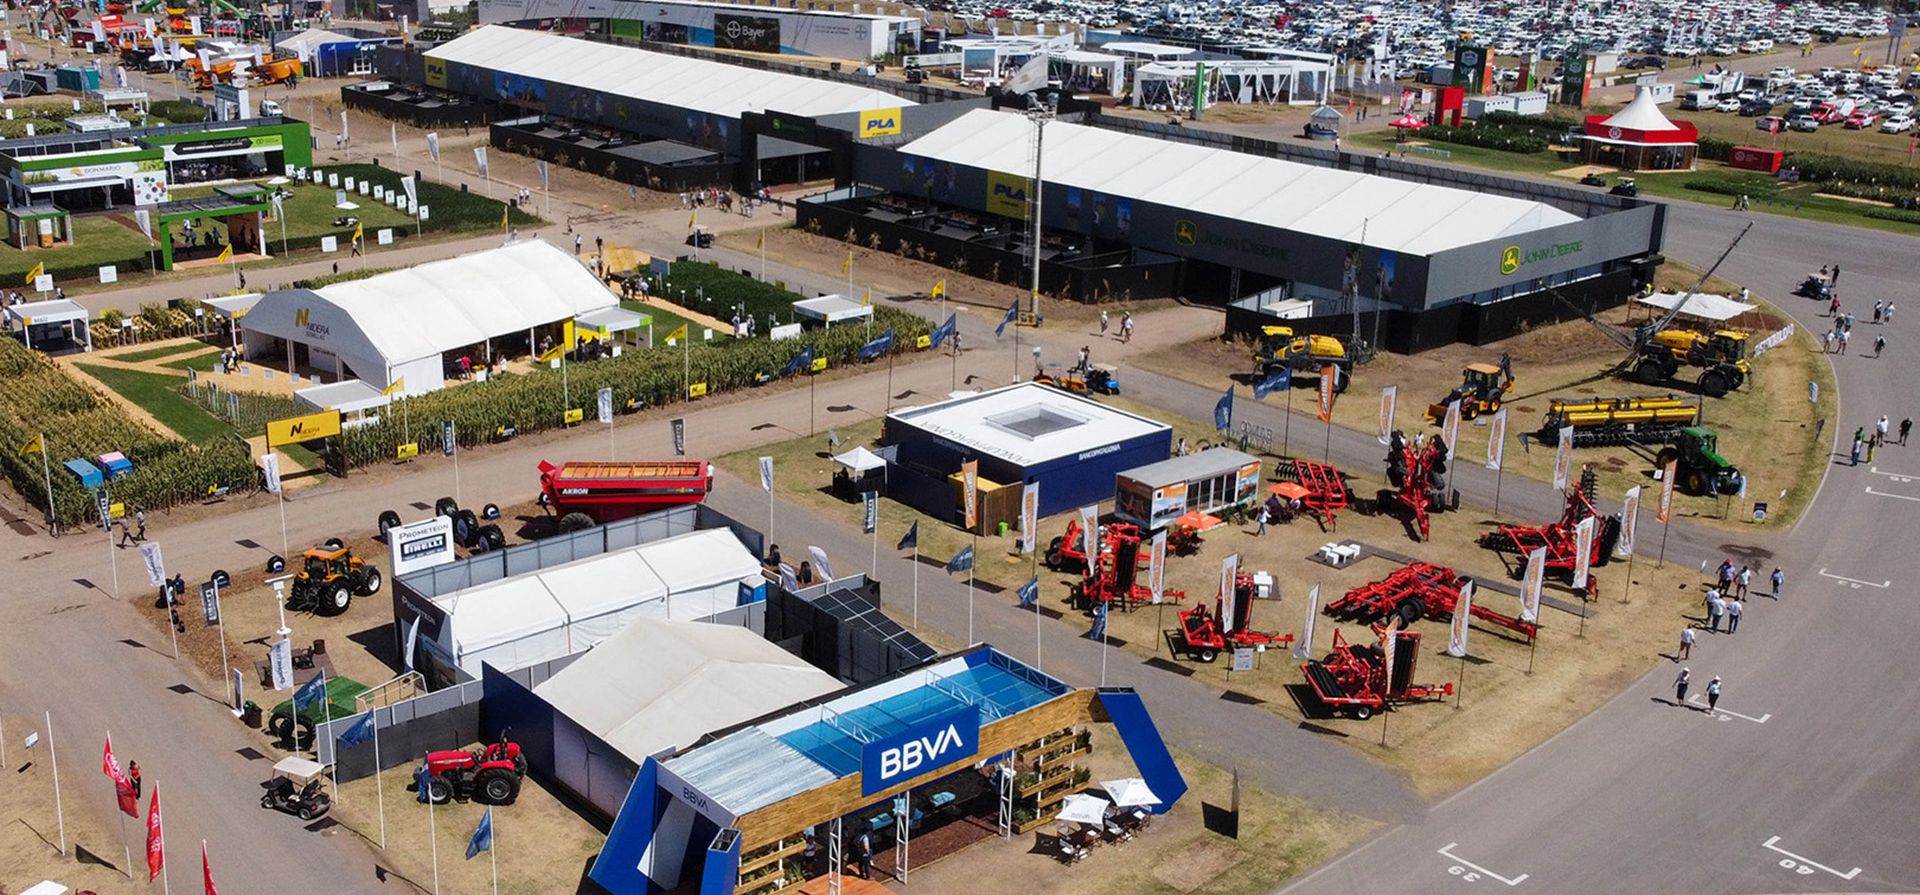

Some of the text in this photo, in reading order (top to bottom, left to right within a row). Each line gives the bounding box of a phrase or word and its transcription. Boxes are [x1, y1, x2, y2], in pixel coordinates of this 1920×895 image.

[741, 25, 766, 44] Bayer
[866, 117, 895, 131] PLA
[994, 183, 1026, 202] PLA
[1520, 241, 1584, 266] JOHN DEERE
[398, 523, 449, 540] PROMETEON
[881, 723, 963, 779] BBVA
[683, 786, 709, 812] BBVA
[1448, 865, 1481, 882] 39
[1779, 859, 1815, 875] 40
